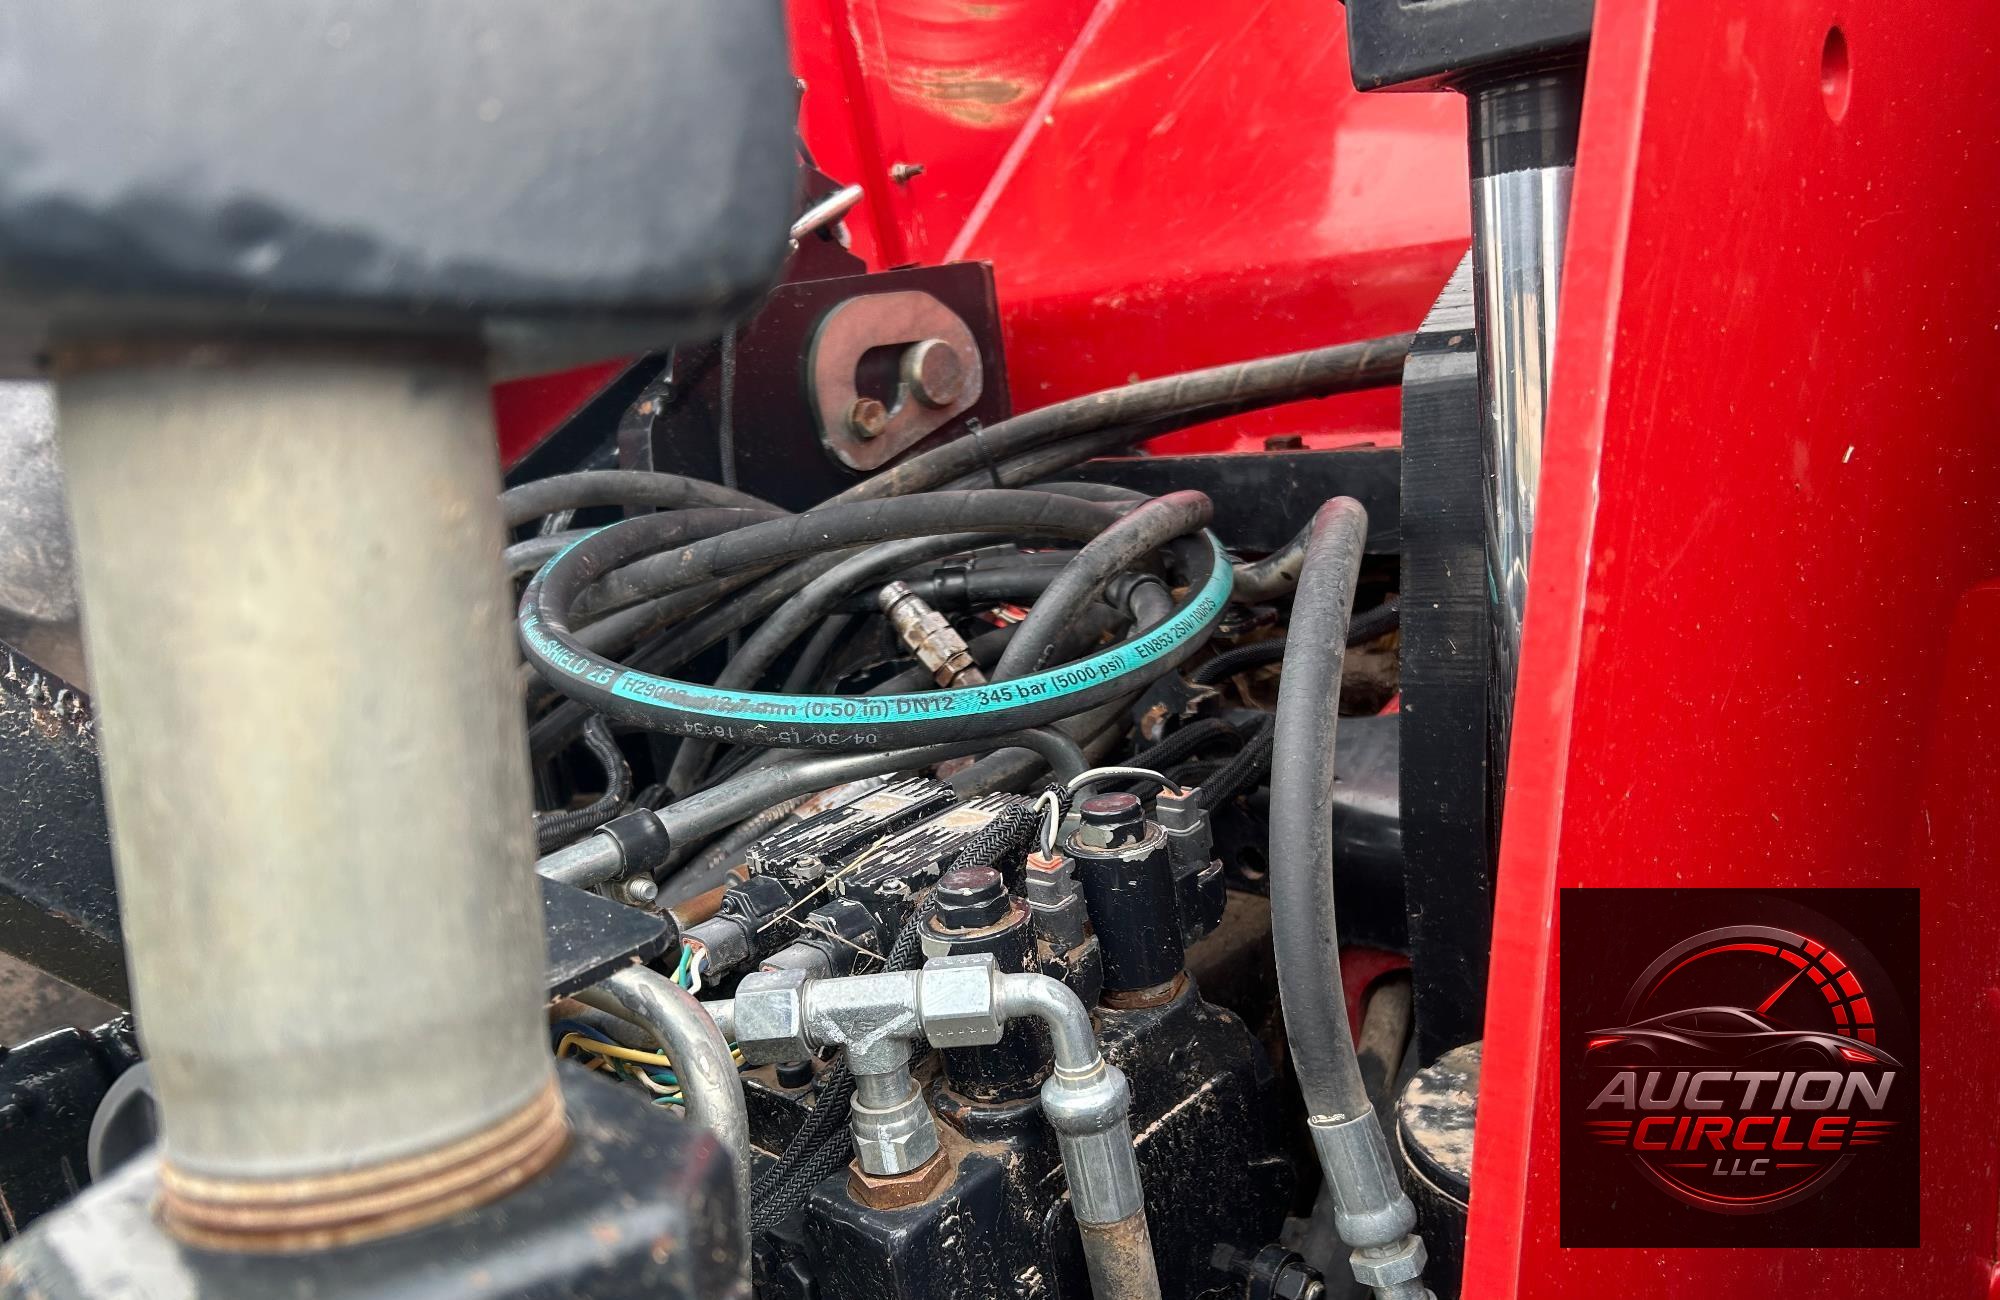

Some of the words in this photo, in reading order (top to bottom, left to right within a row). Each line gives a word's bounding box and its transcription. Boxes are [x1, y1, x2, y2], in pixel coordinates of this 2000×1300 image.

[804, 701, 855, 718] (0.50
[862, 700, 889, 718] in)
[896, 696, 955, 715] DN12
[977, 686, 1013, 706] 345
[1016, 681, 1047, 699] bar
[1051, 666, 1097, 692] (5000
[1099, 655, 1126, 679] psi)
[1134, 632, 1174, 659] EN853
